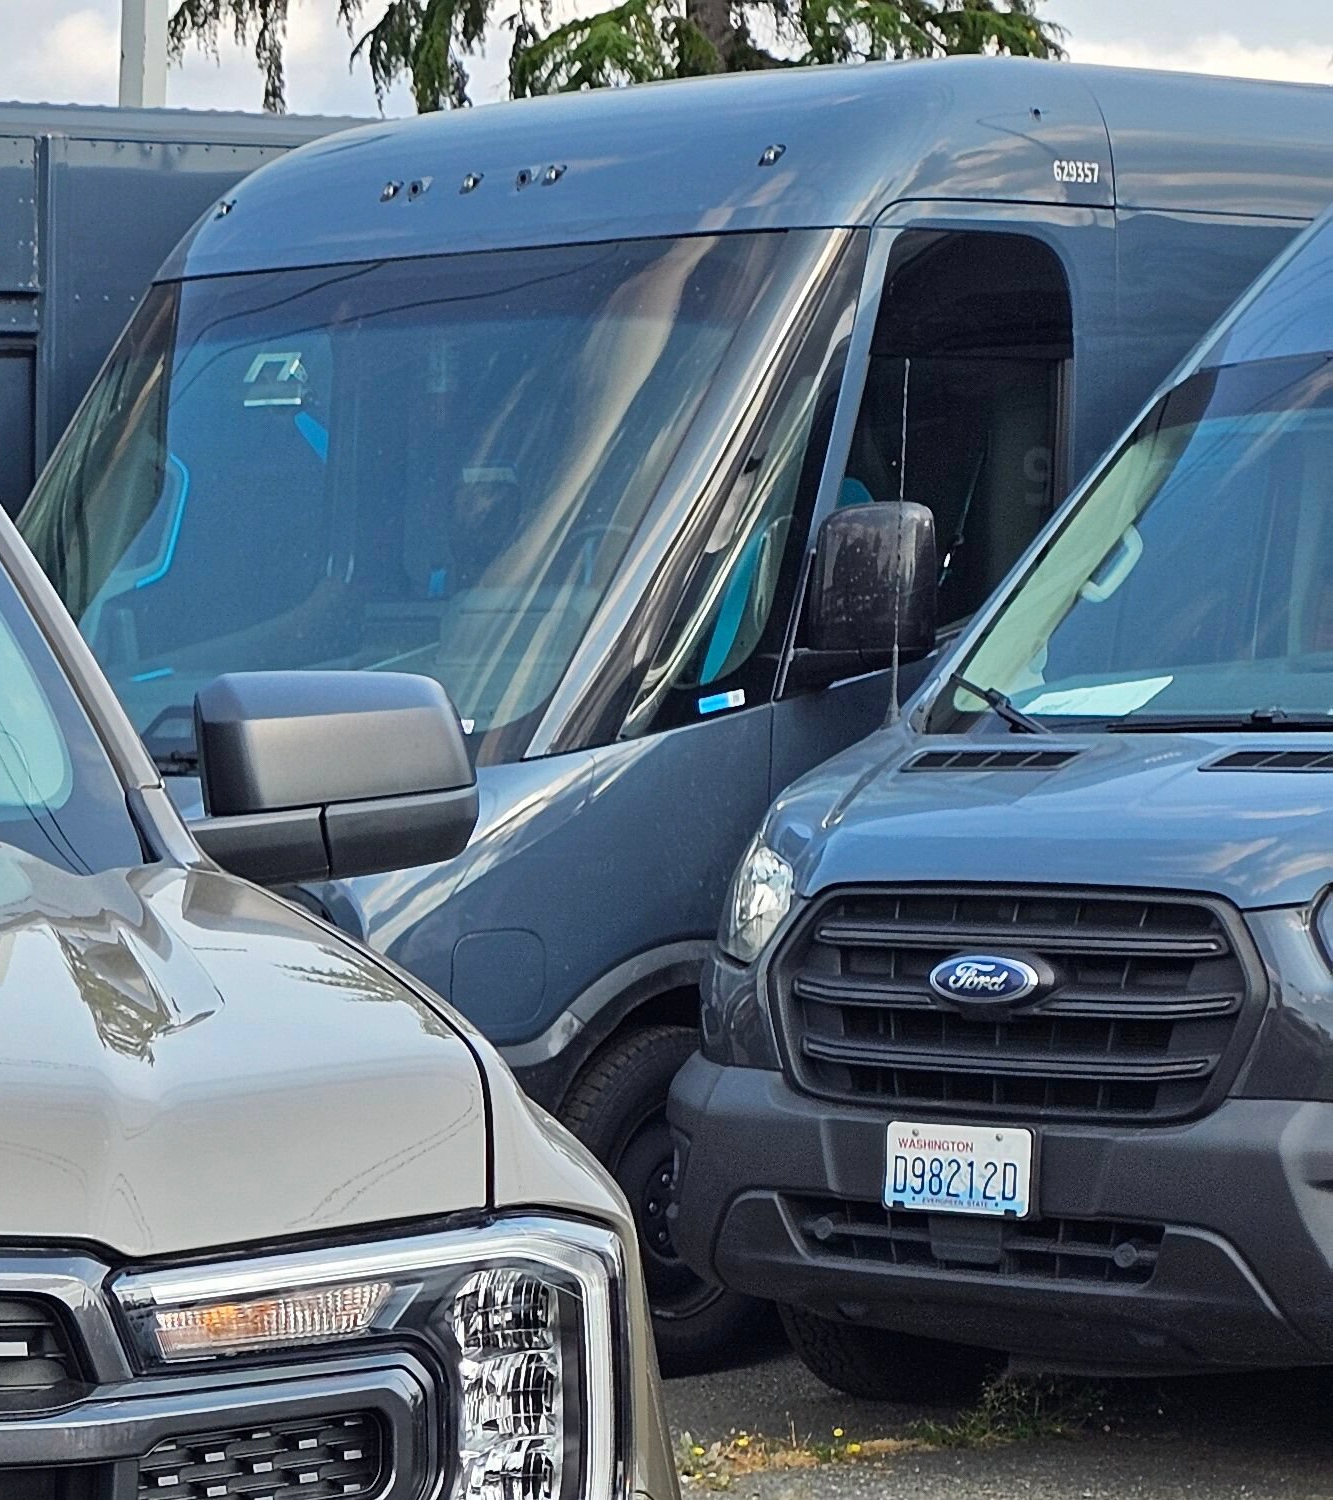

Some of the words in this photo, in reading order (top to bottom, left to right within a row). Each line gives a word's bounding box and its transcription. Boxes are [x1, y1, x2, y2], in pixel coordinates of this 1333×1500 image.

[1052, 159, 1100, 184] 629357
[948, 961, 1009, 991] Ford
[897, 1137, 975, 1153] WASHINGTON
[892, 1154, 1018, 1201] D98212D
[966, 1199, 989, 1208] STATE
